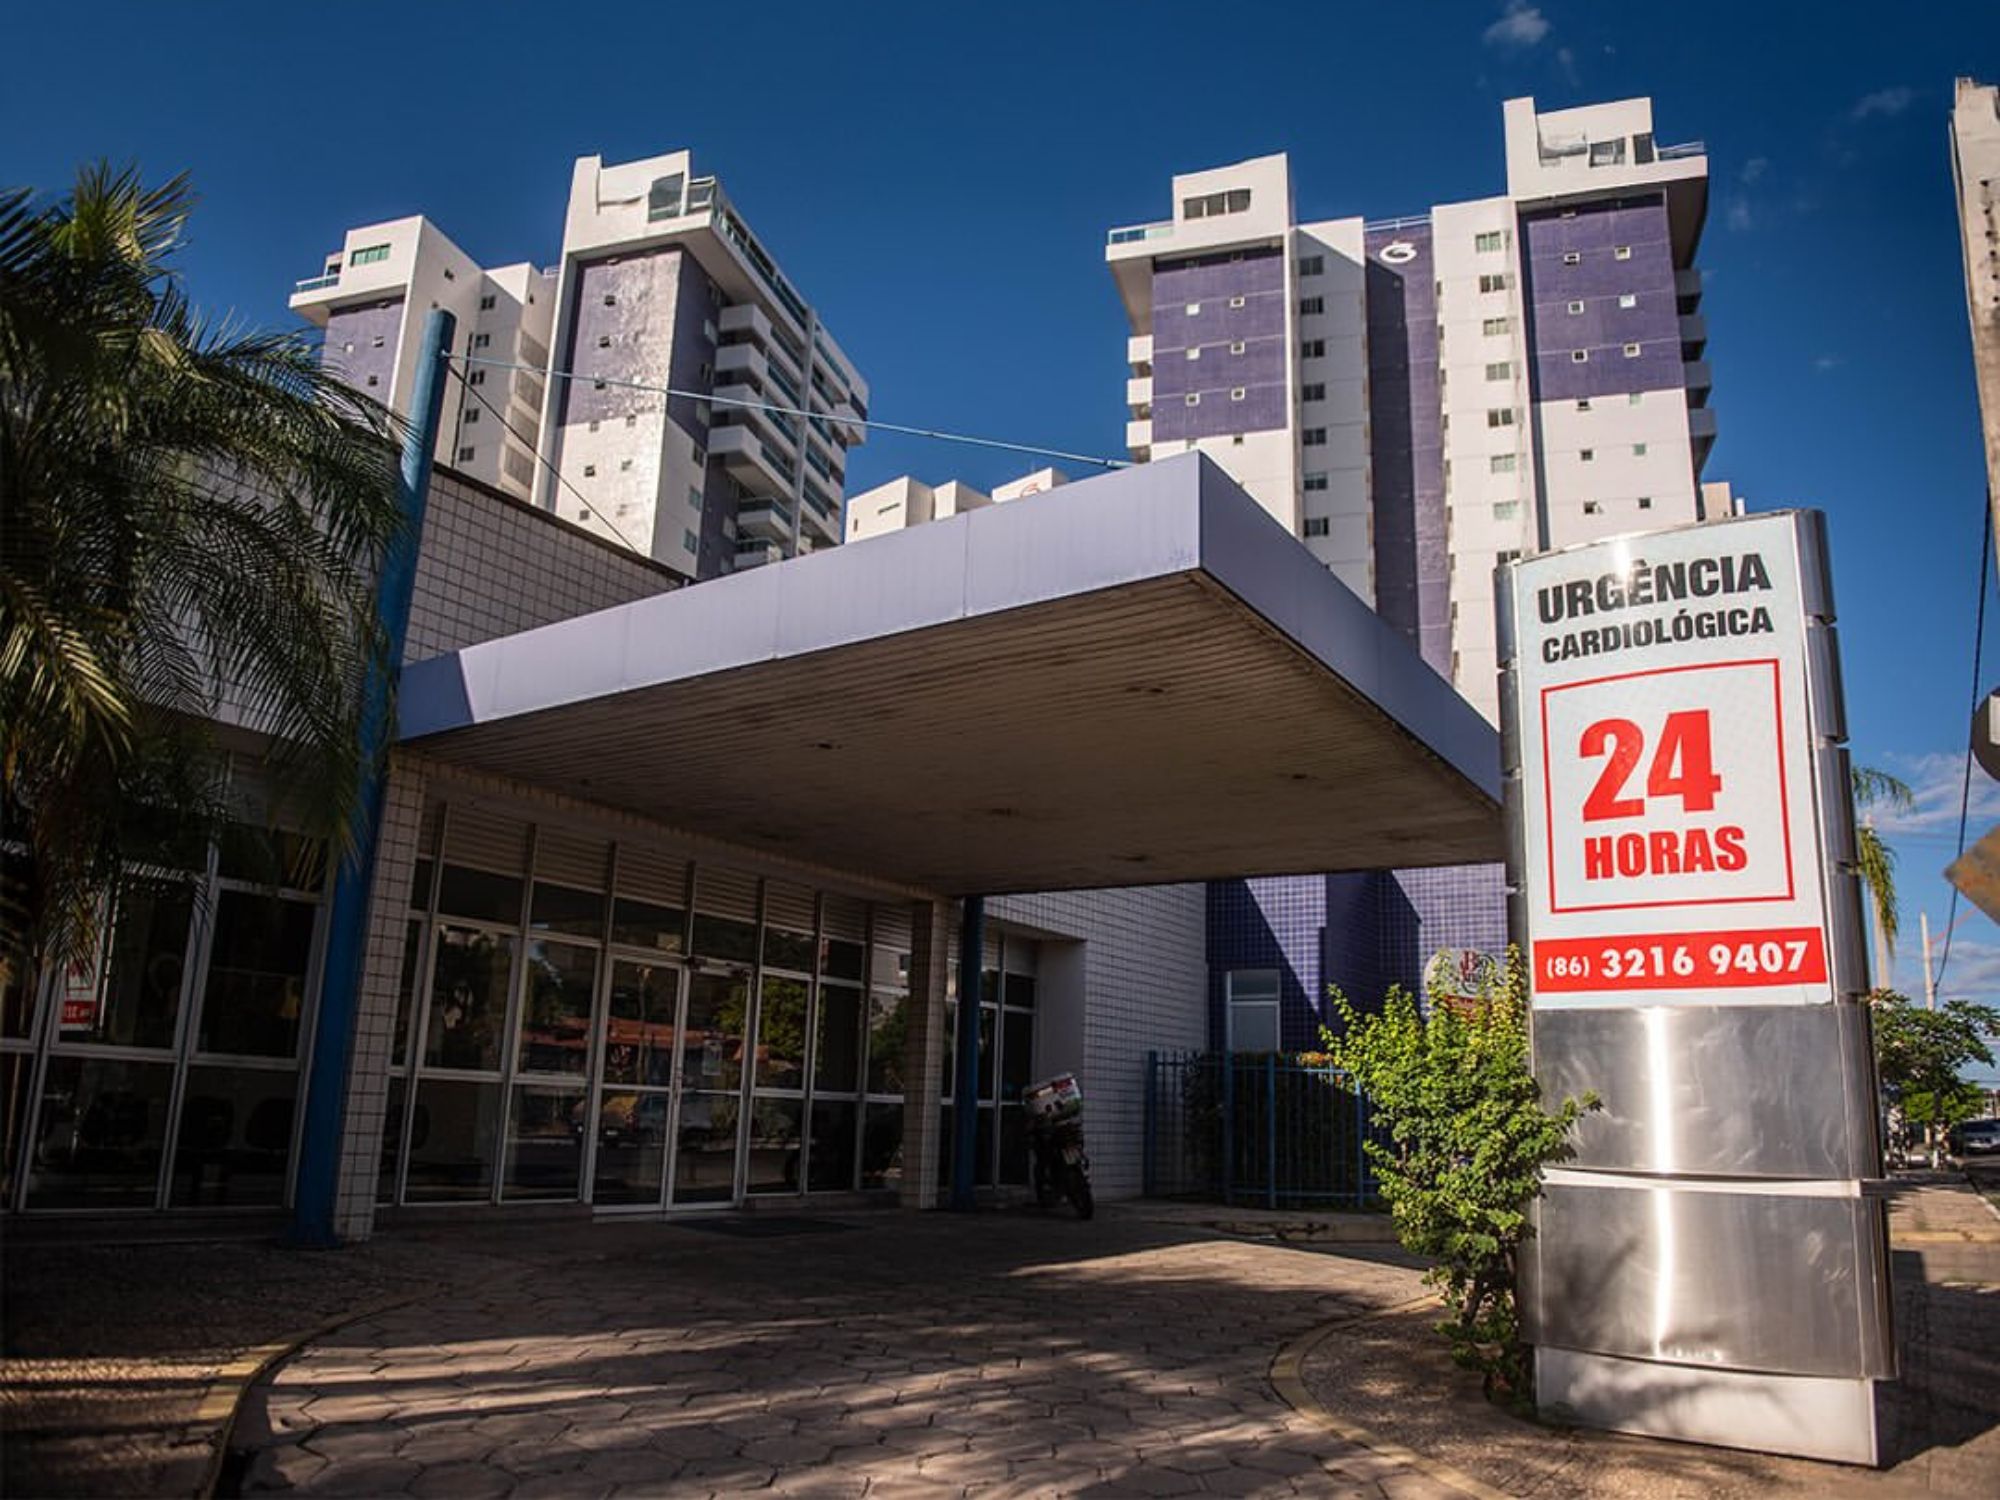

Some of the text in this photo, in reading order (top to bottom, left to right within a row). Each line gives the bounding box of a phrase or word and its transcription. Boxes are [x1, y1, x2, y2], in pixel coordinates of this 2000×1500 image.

[1542, 607, 1774, 664] CARDIOLÓGICA
[1579, 709, 1722, 822] 24
[1584, 826, 1748, 880] HORAS
[1546, 942, 1808, 979] (86) 3216 9407
